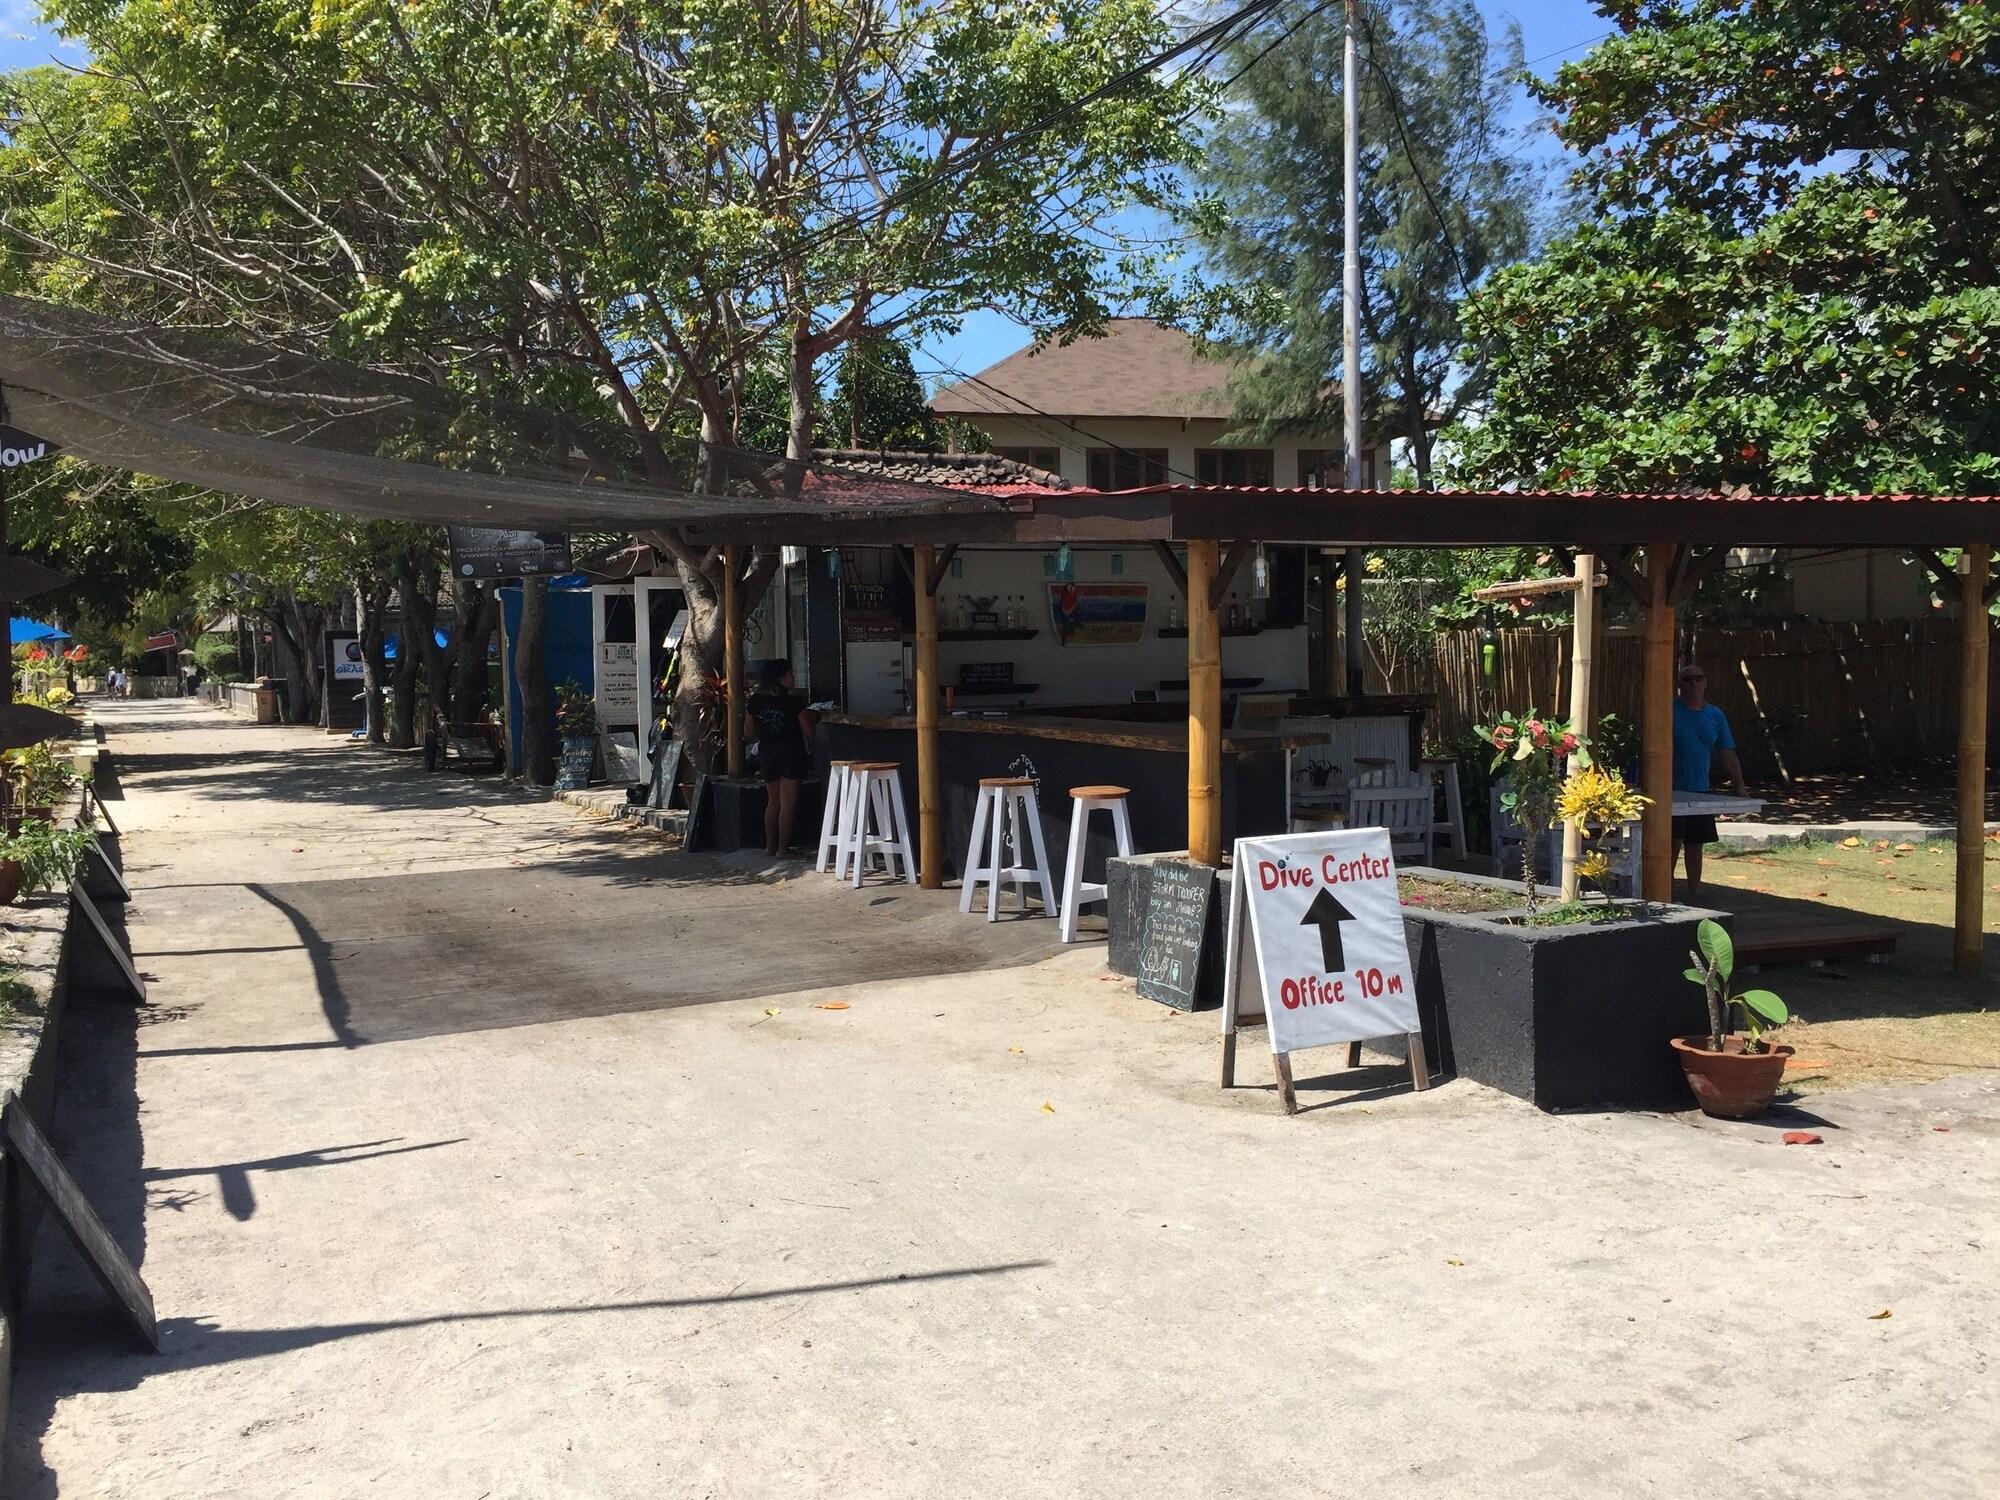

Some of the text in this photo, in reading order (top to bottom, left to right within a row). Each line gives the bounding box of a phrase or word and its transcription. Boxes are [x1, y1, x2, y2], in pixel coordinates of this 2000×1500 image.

[1153, 864, 1167, 882] Why
[1259, 852, 1389, 890] Dive Center
[1281, 975, 1345, 1009] Office
[1355, 968, 1383, 998] 10
